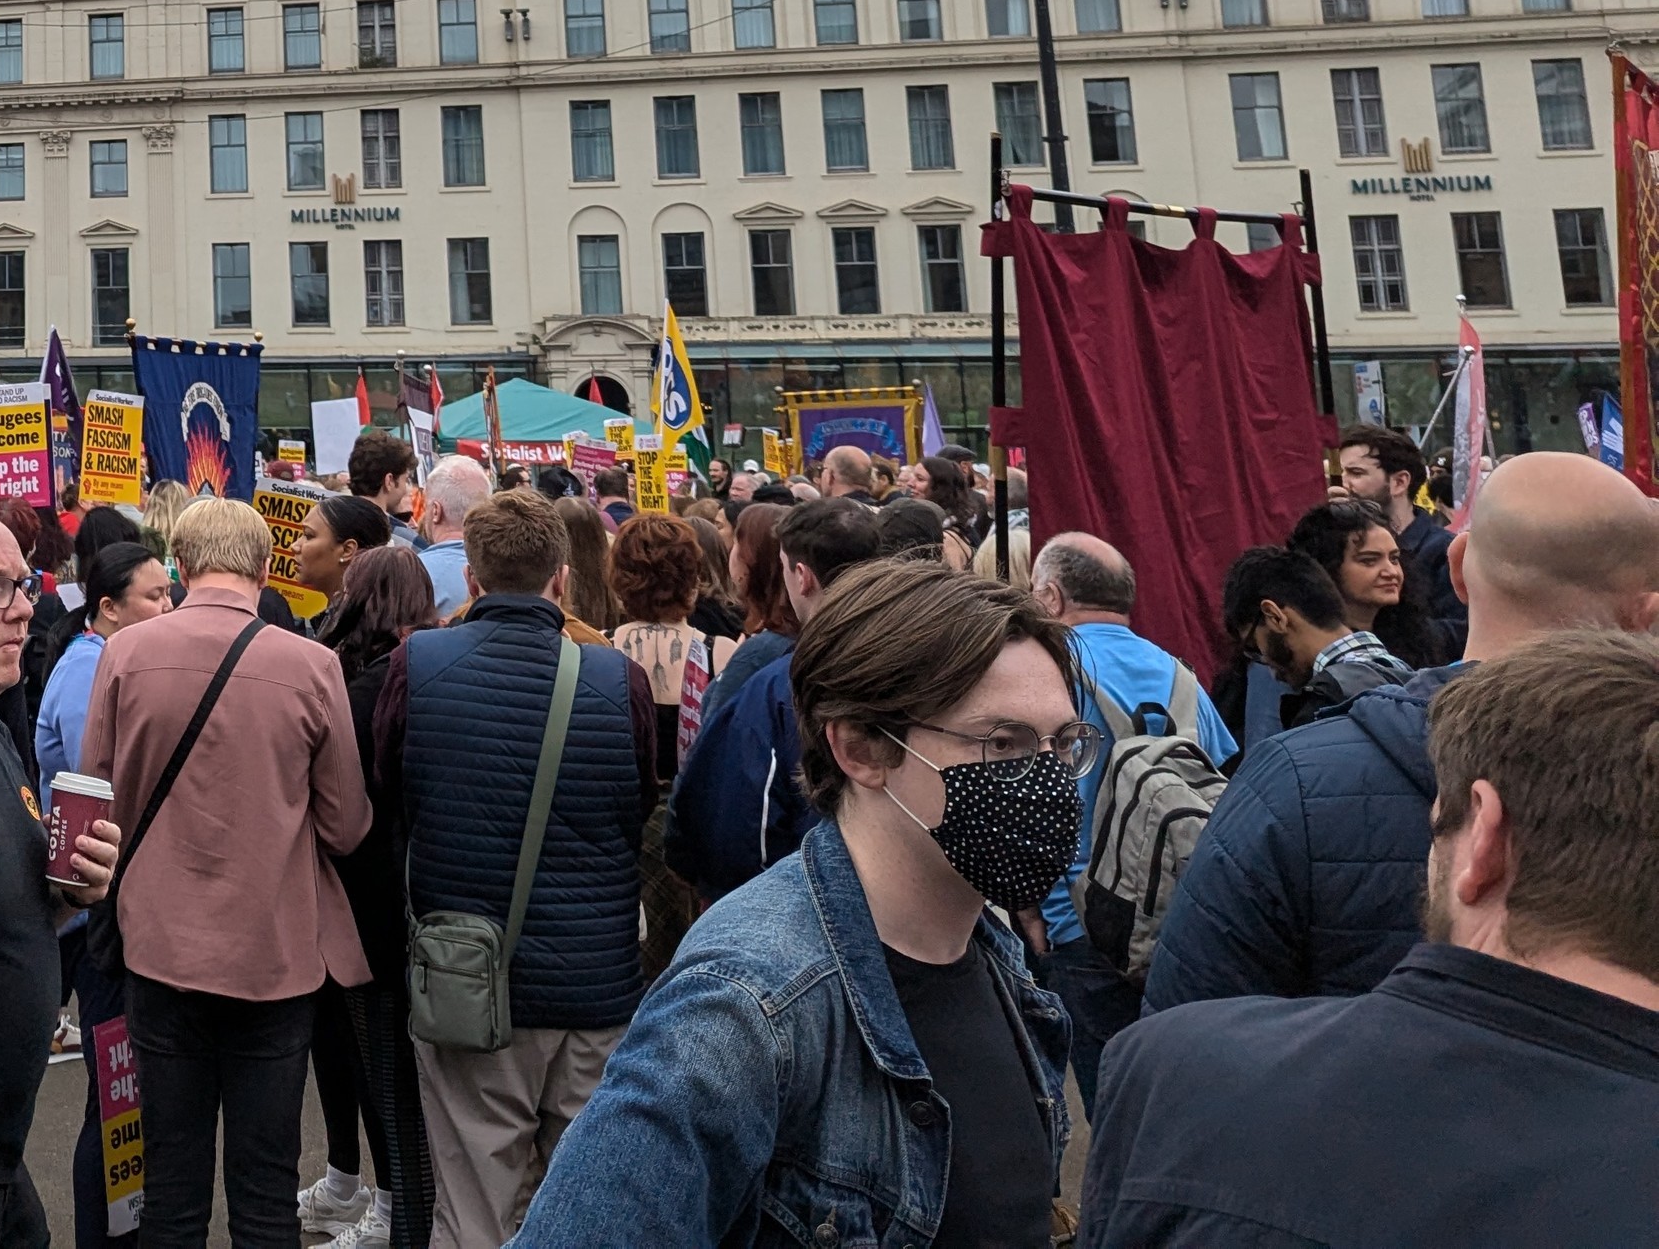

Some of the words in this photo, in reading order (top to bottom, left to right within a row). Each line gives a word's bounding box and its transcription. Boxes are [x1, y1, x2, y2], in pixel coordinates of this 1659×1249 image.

[1351, 175, 1493, 195] MILLENNIUM
[291, 207, 400, 223] MILLENNIUM
[4, 395, 28, 403] RACISM
[88, 405, 124, 426] SMASH
[86, 429, 131, 450] FASCISM
[12, 456, 39, 474] the
[85, 452, 93, 470] &
[97, 453, 137, 474] RACISM
[638, 452, 657, 465] STOP
[639, 466, 652, 479] THE
[0, 476, 39, 497] right
[641, 481, 652, 494] FAR
[642, 495, 664, 509] RIGHT
[48, 805, 61, 861] COSTA
[60, 819, 68, 850] COFFEE
